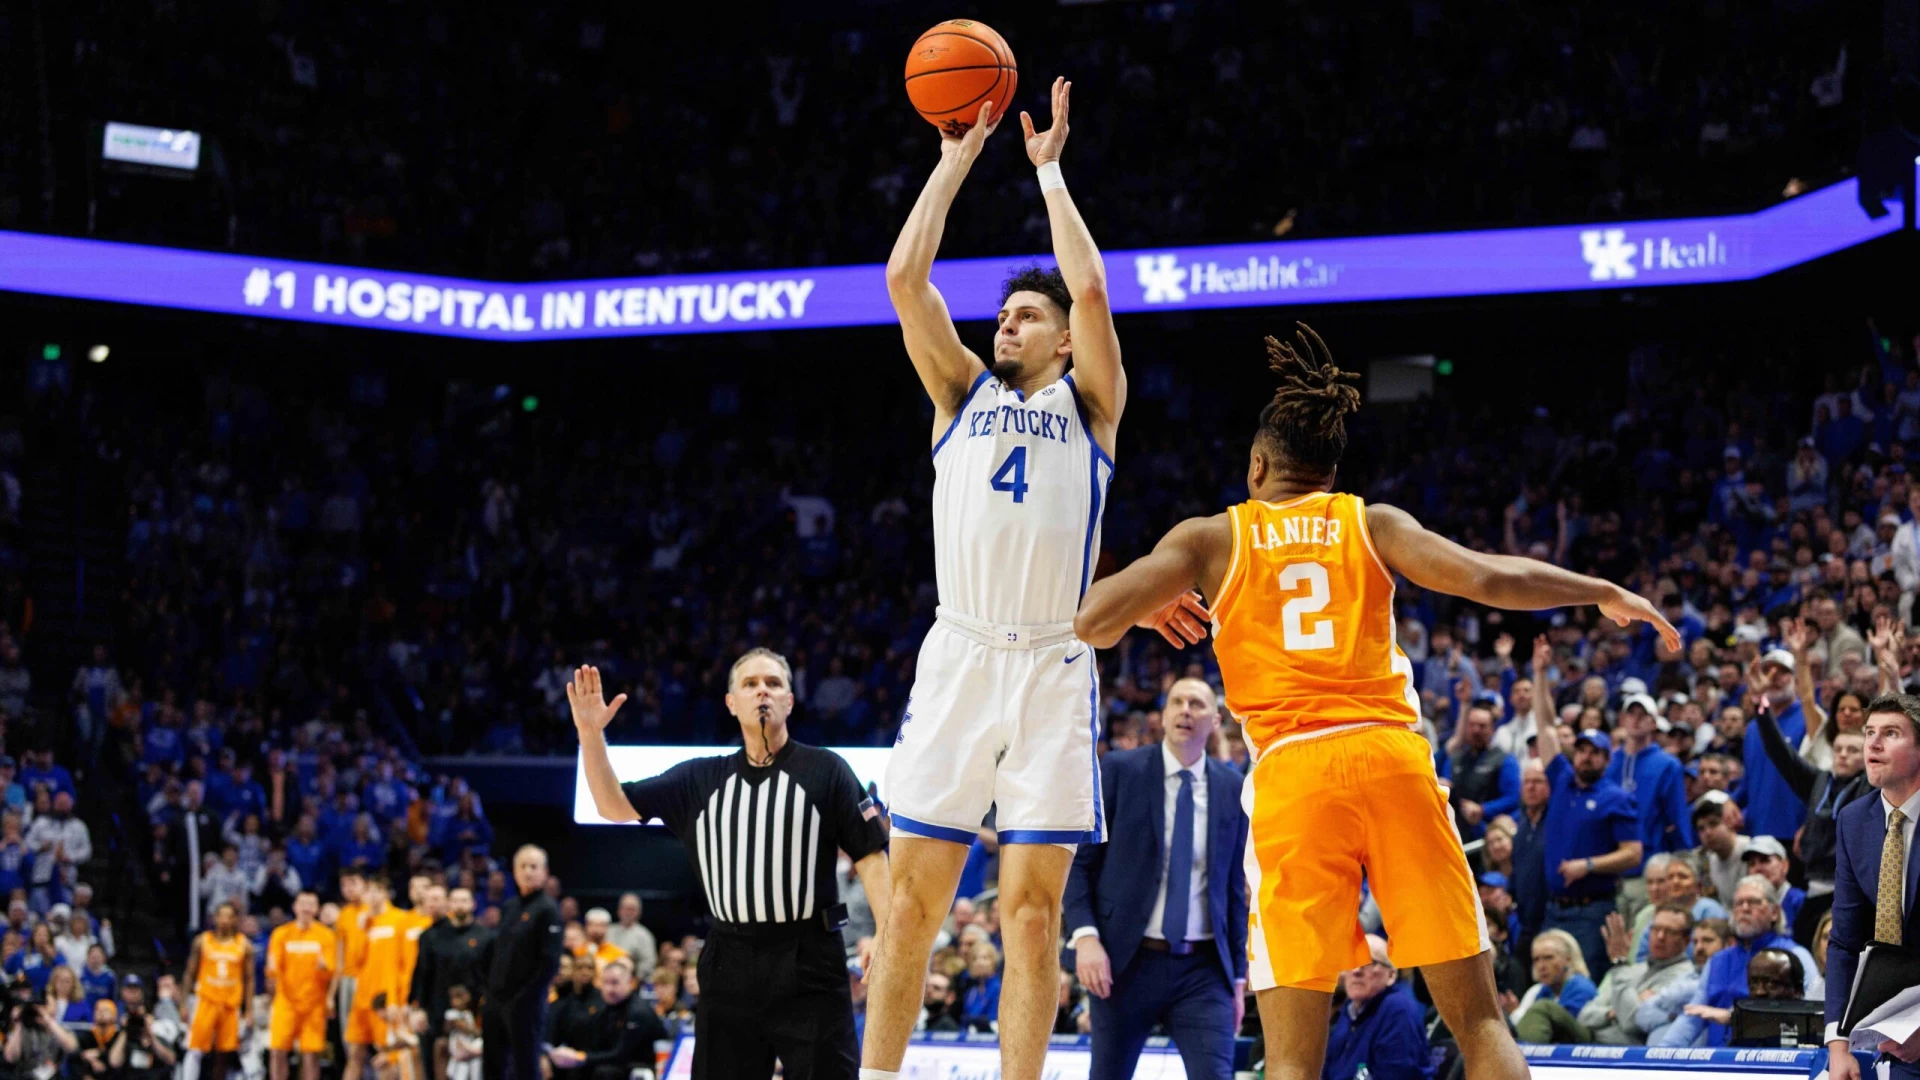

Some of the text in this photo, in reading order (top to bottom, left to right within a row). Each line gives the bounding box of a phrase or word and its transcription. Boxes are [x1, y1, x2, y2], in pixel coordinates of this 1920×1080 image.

[243, 267, 814, 332] #1 HOSPITAL IN KENTUCKY
[990, 446, 1028, 503] 4
[1251, 516, 1340, 550] LANIER
[1278, 561, 1335, 650] 2
